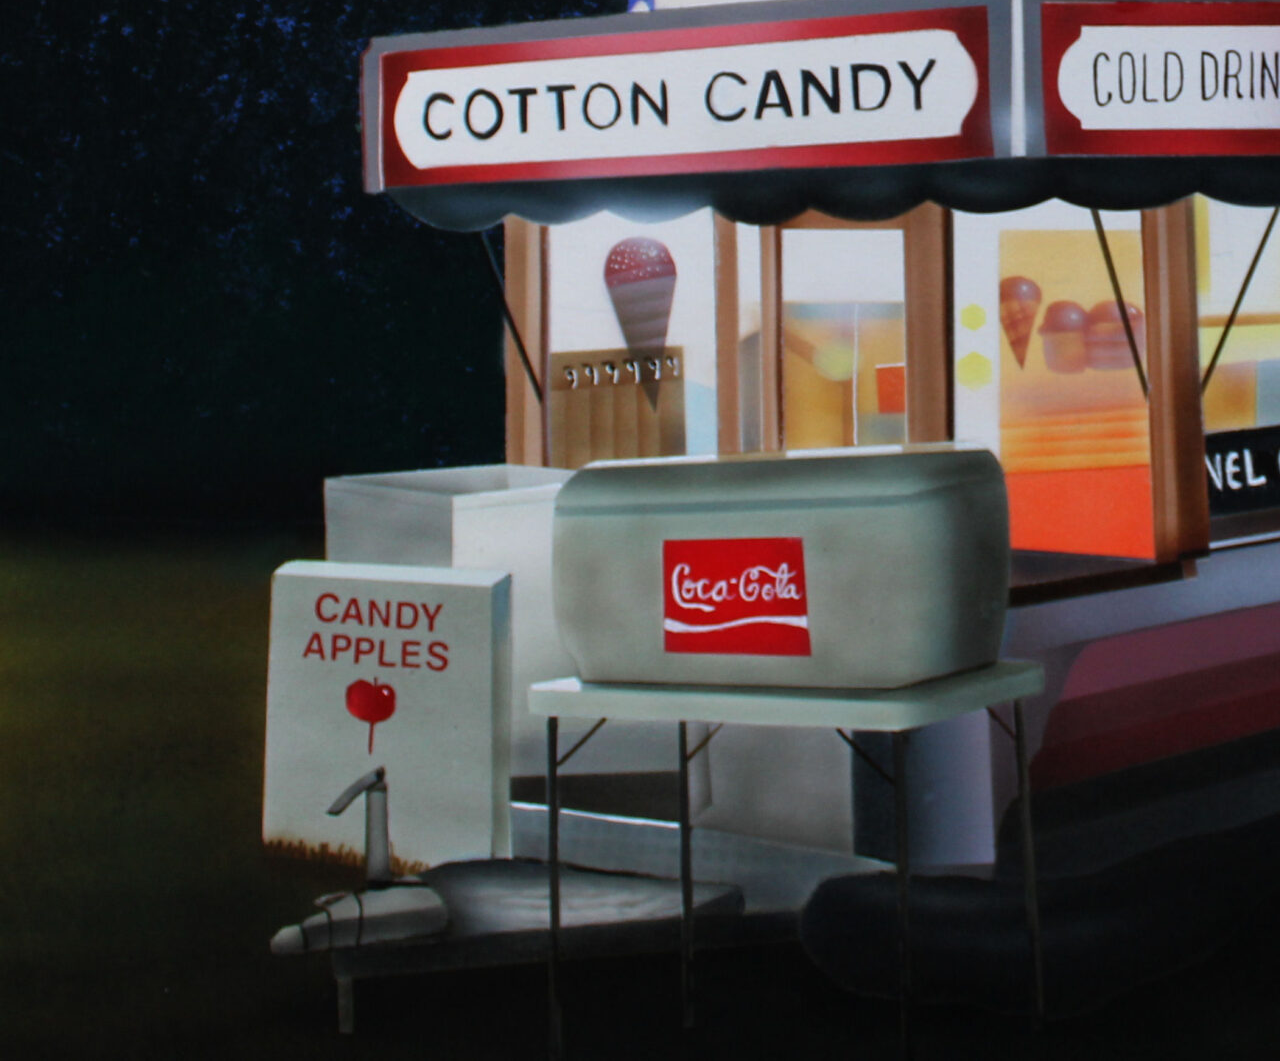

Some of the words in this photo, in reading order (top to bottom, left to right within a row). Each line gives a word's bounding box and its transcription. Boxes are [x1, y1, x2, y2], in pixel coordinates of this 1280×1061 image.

[422, 78, 669, 141] COTTON
[704, 59, 938, 123] CANDY
[1092, 51, 1184, 107] COLD
[314, 592, 444, 633] CANDY
[302, 632, 451, 673] APPLES
